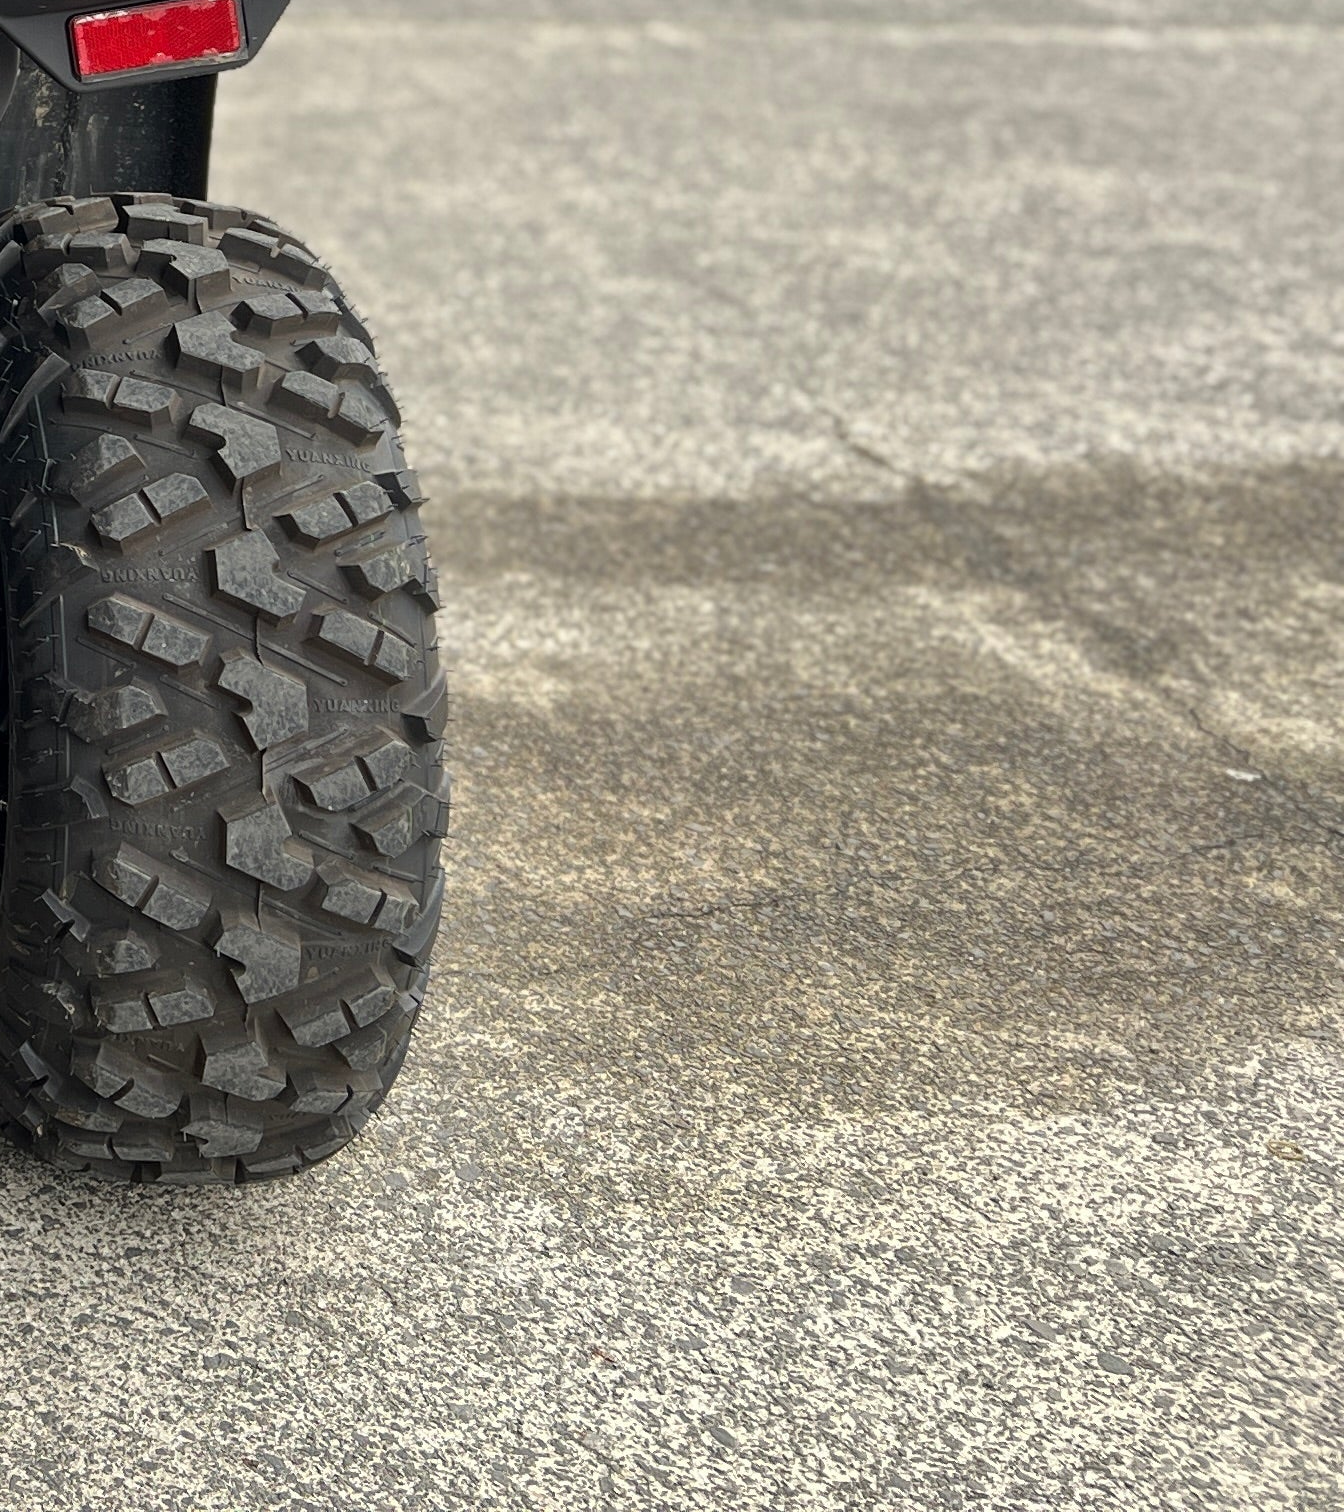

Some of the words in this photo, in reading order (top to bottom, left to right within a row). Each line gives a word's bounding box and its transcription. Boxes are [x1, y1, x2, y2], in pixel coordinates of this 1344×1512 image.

[285, 447, 371, 473] YUANXING
[100, 565, 199, 583] YUANXING
[312, 696, 401, 713] YUANXING
